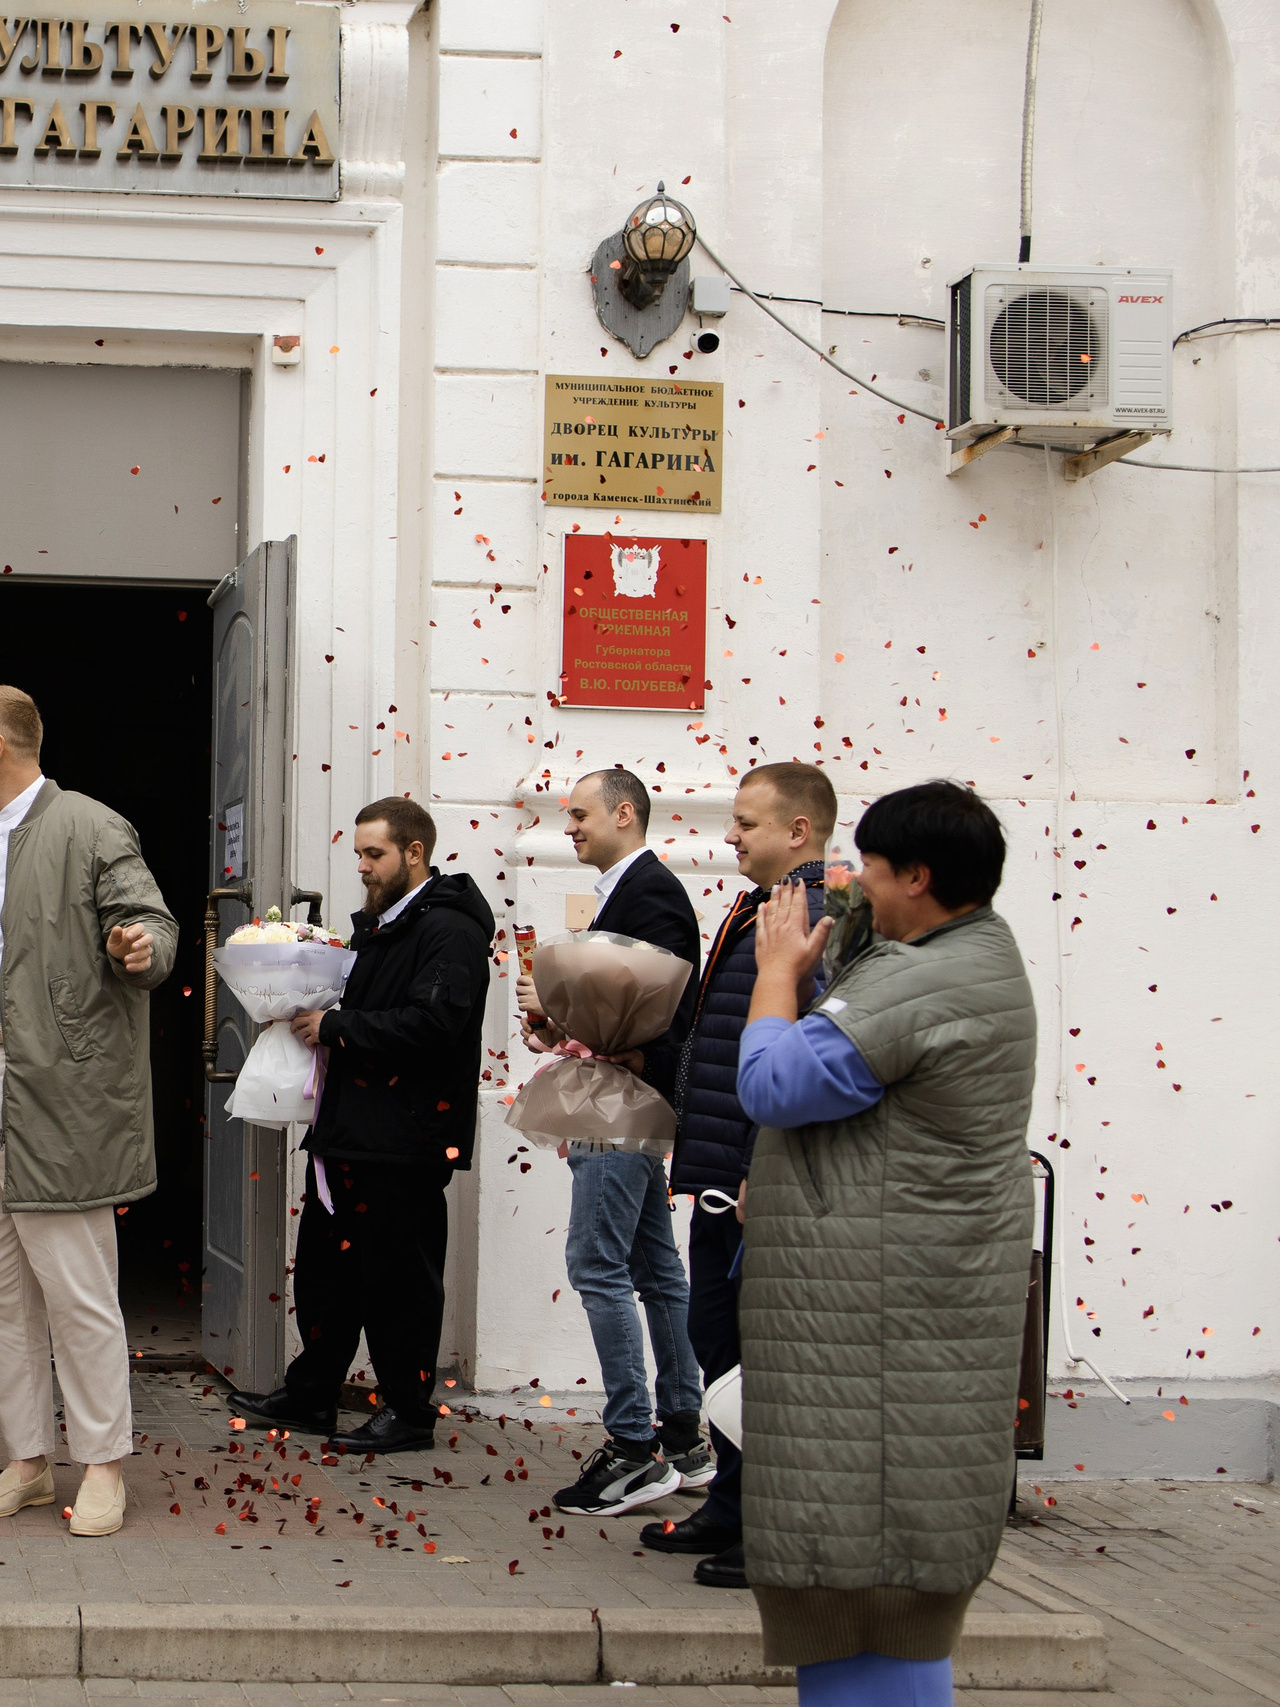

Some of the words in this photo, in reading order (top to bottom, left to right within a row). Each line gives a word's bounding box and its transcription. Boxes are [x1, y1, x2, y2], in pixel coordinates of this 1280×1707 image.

[1117, 295, 1164, 304] AVEX
[555, 382, 645, 394] МУНИЦИПАЛЬНОЕ
[650, 386, 714, 398] БЮДЖЕТНОЕ
[573, 396, 639, 407] УЧРЕЖДЕНИЕ
[644, 399, 697, 410] КУЛЬТУРЫ
[551, 422, 619, 438] ДВОРЕЦ
[628, 425, 716, 441] КУЛЬТУРЫ
[595, 450, 716, 473] ГАГАРИНА
[553, 492, 589, 502] города
[593, 492, 712, 507] Каменск-Шахтинский
[579, 607, 689, 622] ОБЩЕСТВЕННАЯ
[596, 623, 671, 637] ПРИЕМНАЯ
[595, 644, 671, 658] Губернатора
[574, 658, 642, 671] Ростовской
[645, 660, 692, 672] области
[580, 678, 611, 690] В.Ю.
[614, 679, 686, 693] ГОЛУБЕВА
